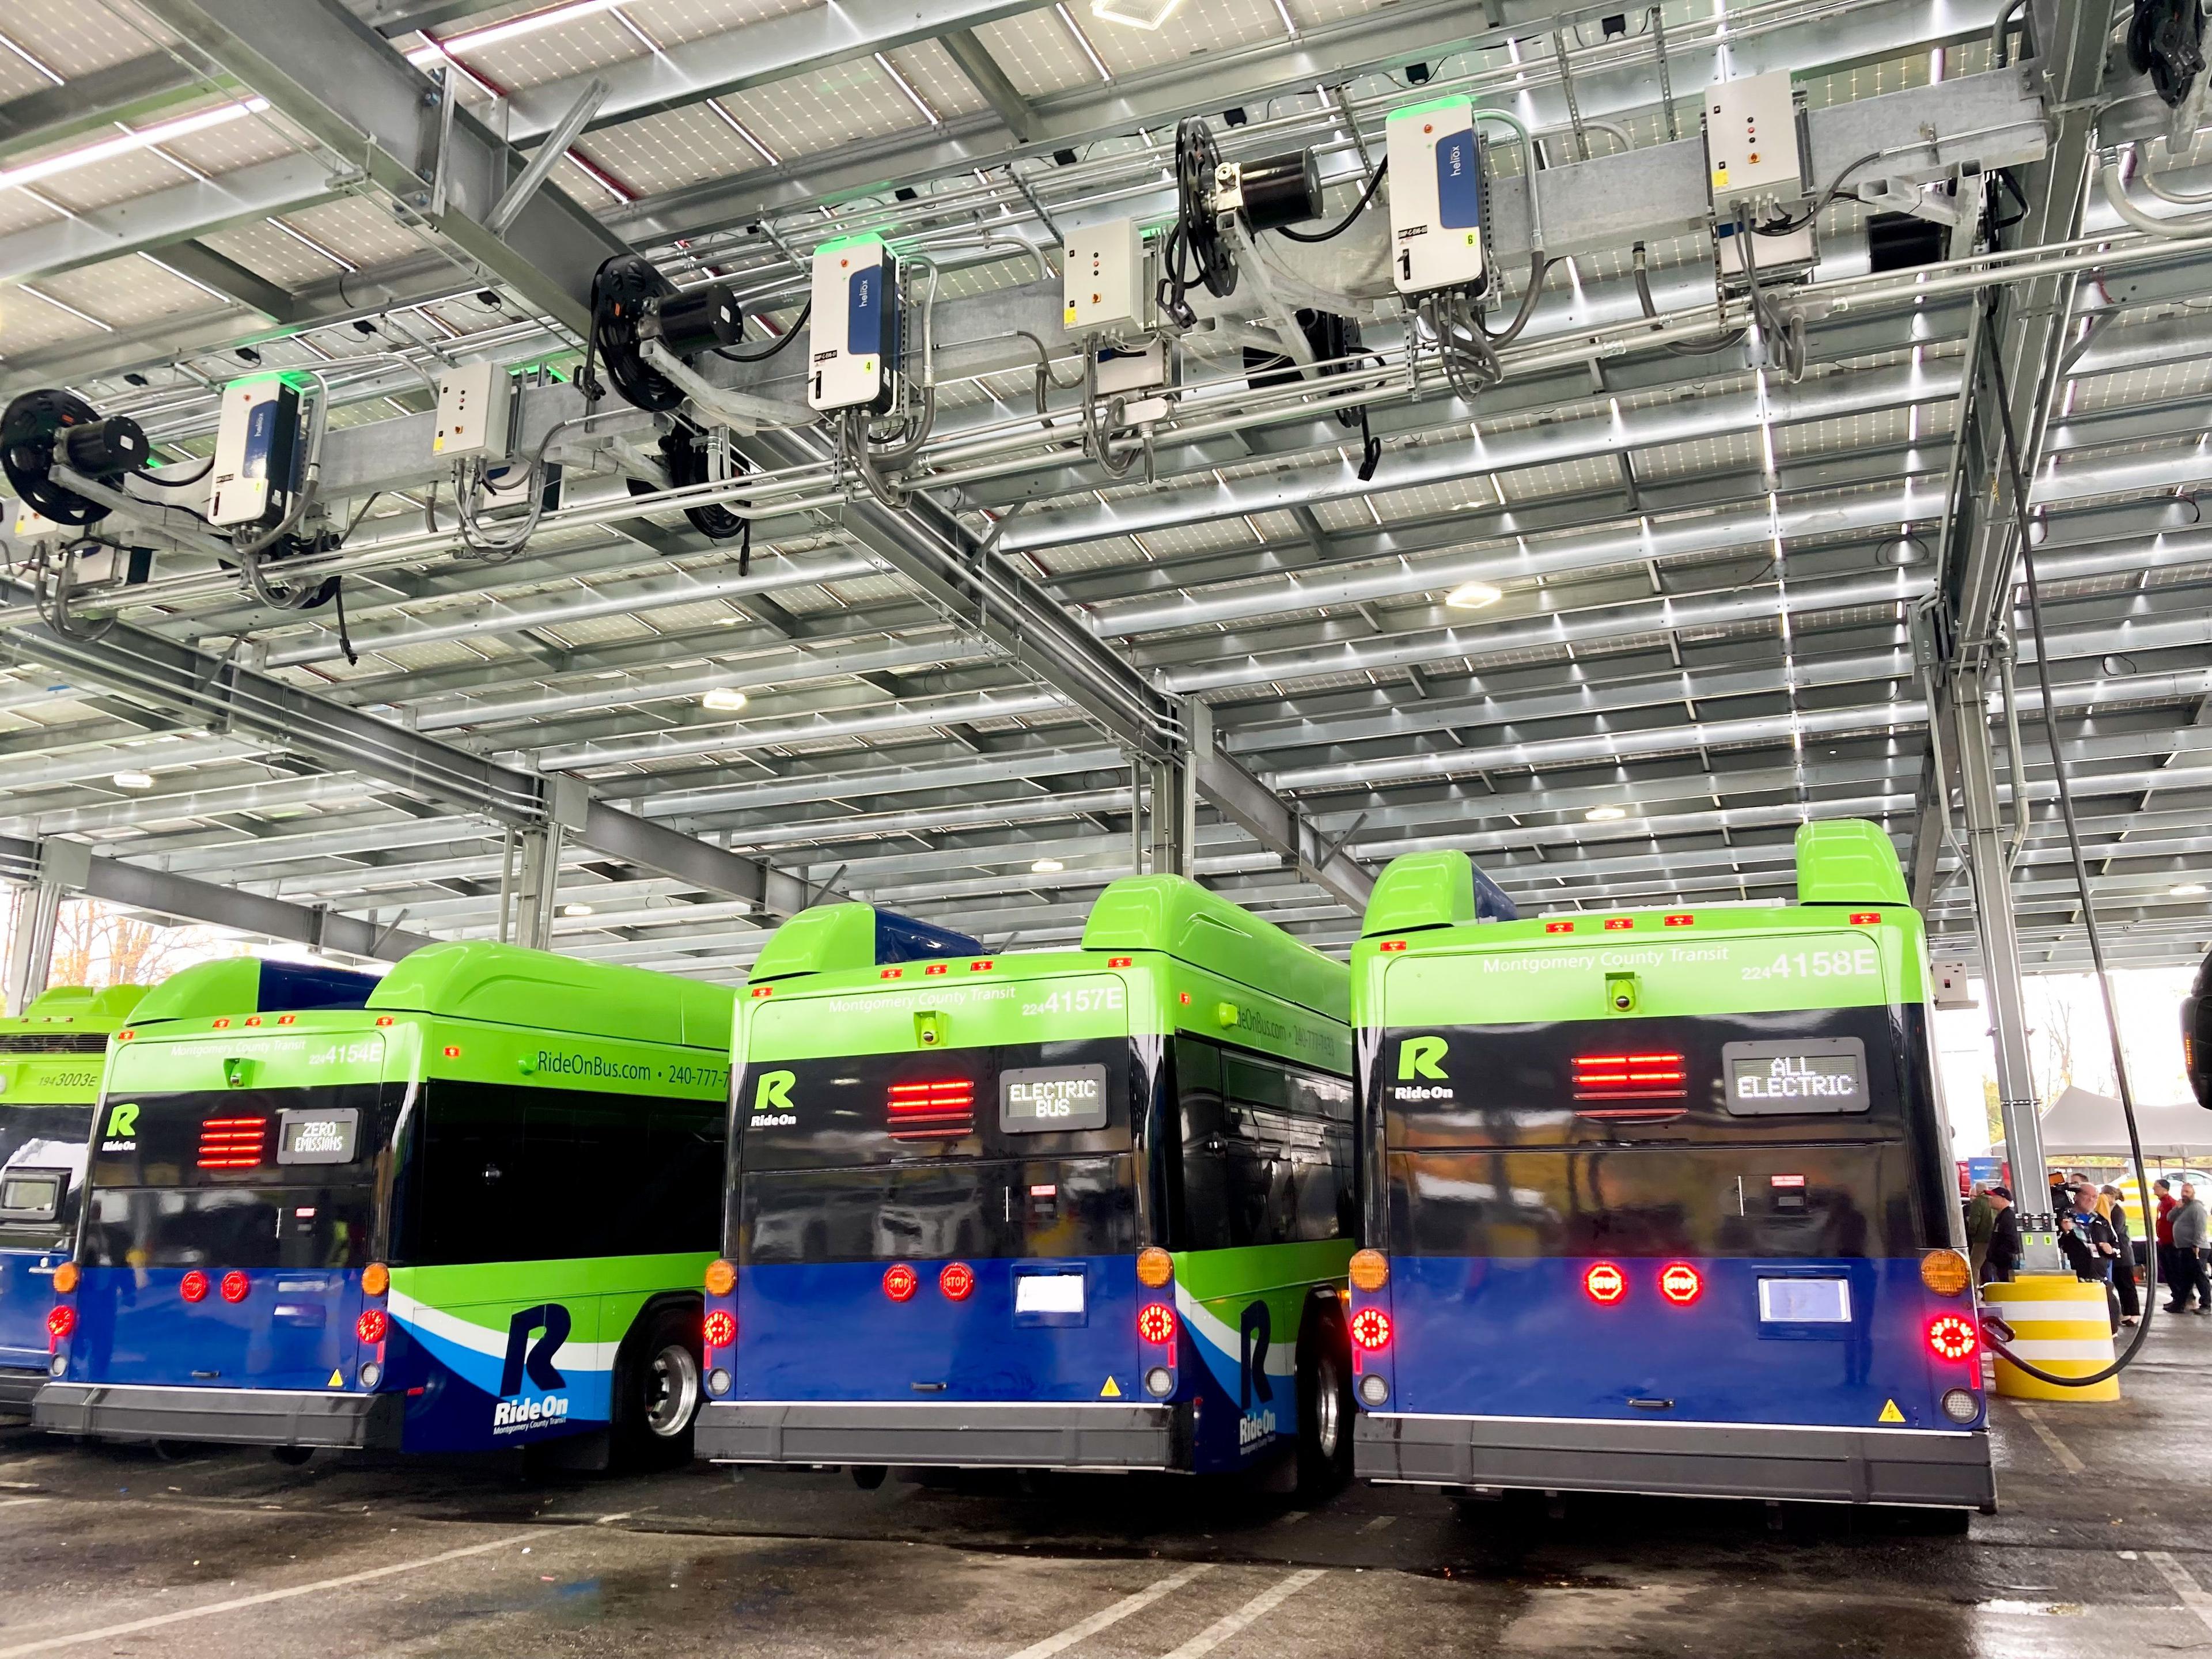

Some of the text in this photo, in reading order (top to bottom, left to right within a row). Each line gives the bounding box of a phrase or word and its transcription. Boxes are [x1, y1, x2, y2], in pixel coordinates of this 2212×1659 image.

[1450, 145, 1461, 176] heliox
[1468, 235, 1472, 244] 6
[859, 279, 868, 307] heliox
[866, 362, 870, 370] 4
[254, 412, 264, 437] heliox
[1483, 946, 1729, 974] Montgomery County Transit
[829, 986, 1016, 1013] Montgomery County Transit
[171, 1040, 306, 1056] Montgomery County Transit
[1398, 1036, 1449, 1080] R
[537, 1051, 650, 1081] RideOnBus.com
[1770, 1056, 1816, 1077] ALL
[754, 1070, 796, 1109] R
[1009, 1079, 1096, 1101] ELECTRIC
[1737, 1075, 1853, 1099] ELECTRIC
[1035, 1100, 1070, 1118] BUS
[106, 1103, 139, 1137] R
[302, 1122, 336, 1137] ZERO
[294, 1136, 343, 1152] EMISSIONS
[889, 1277, 909, 1289] STOP
[946, 1276, 966, 1287] STOP
[1592, 1277, 1618, 1289] STOP
[1666, 1277, 1694, 1289] STOP
[499, 1303, 571, 1397] R
[493, 1416, 567, 1435] Montgomery County Transit
